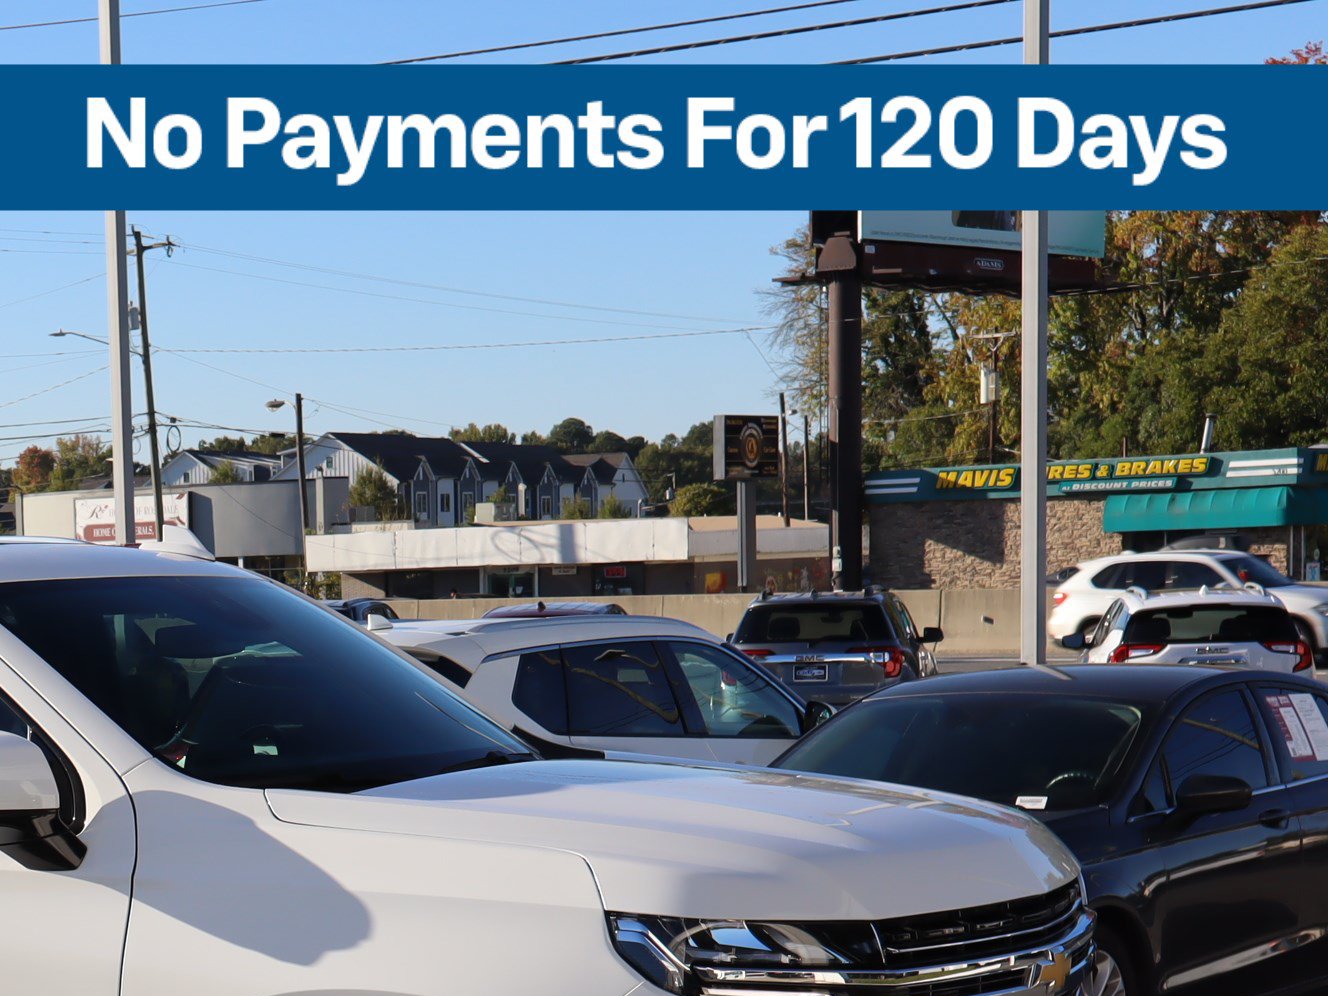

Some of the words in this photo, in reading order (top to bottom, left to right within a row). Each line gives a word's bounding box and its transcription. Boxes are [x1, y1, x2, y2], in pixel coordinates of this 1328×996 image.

[976, 258, 1003, 269] ADAMS
[936, 467, 1015, 490] MAVIS
[1046, 463, 1092, 480] RES
[1096, 463, 1110, 478] &
[1115, 457, 1209, 477] BRAKES
[1072, 481, 1129, 491] DISCOUNT
[1131, 479, 1173, 489] PRICES
[93, 527, 111, 537] HOME
